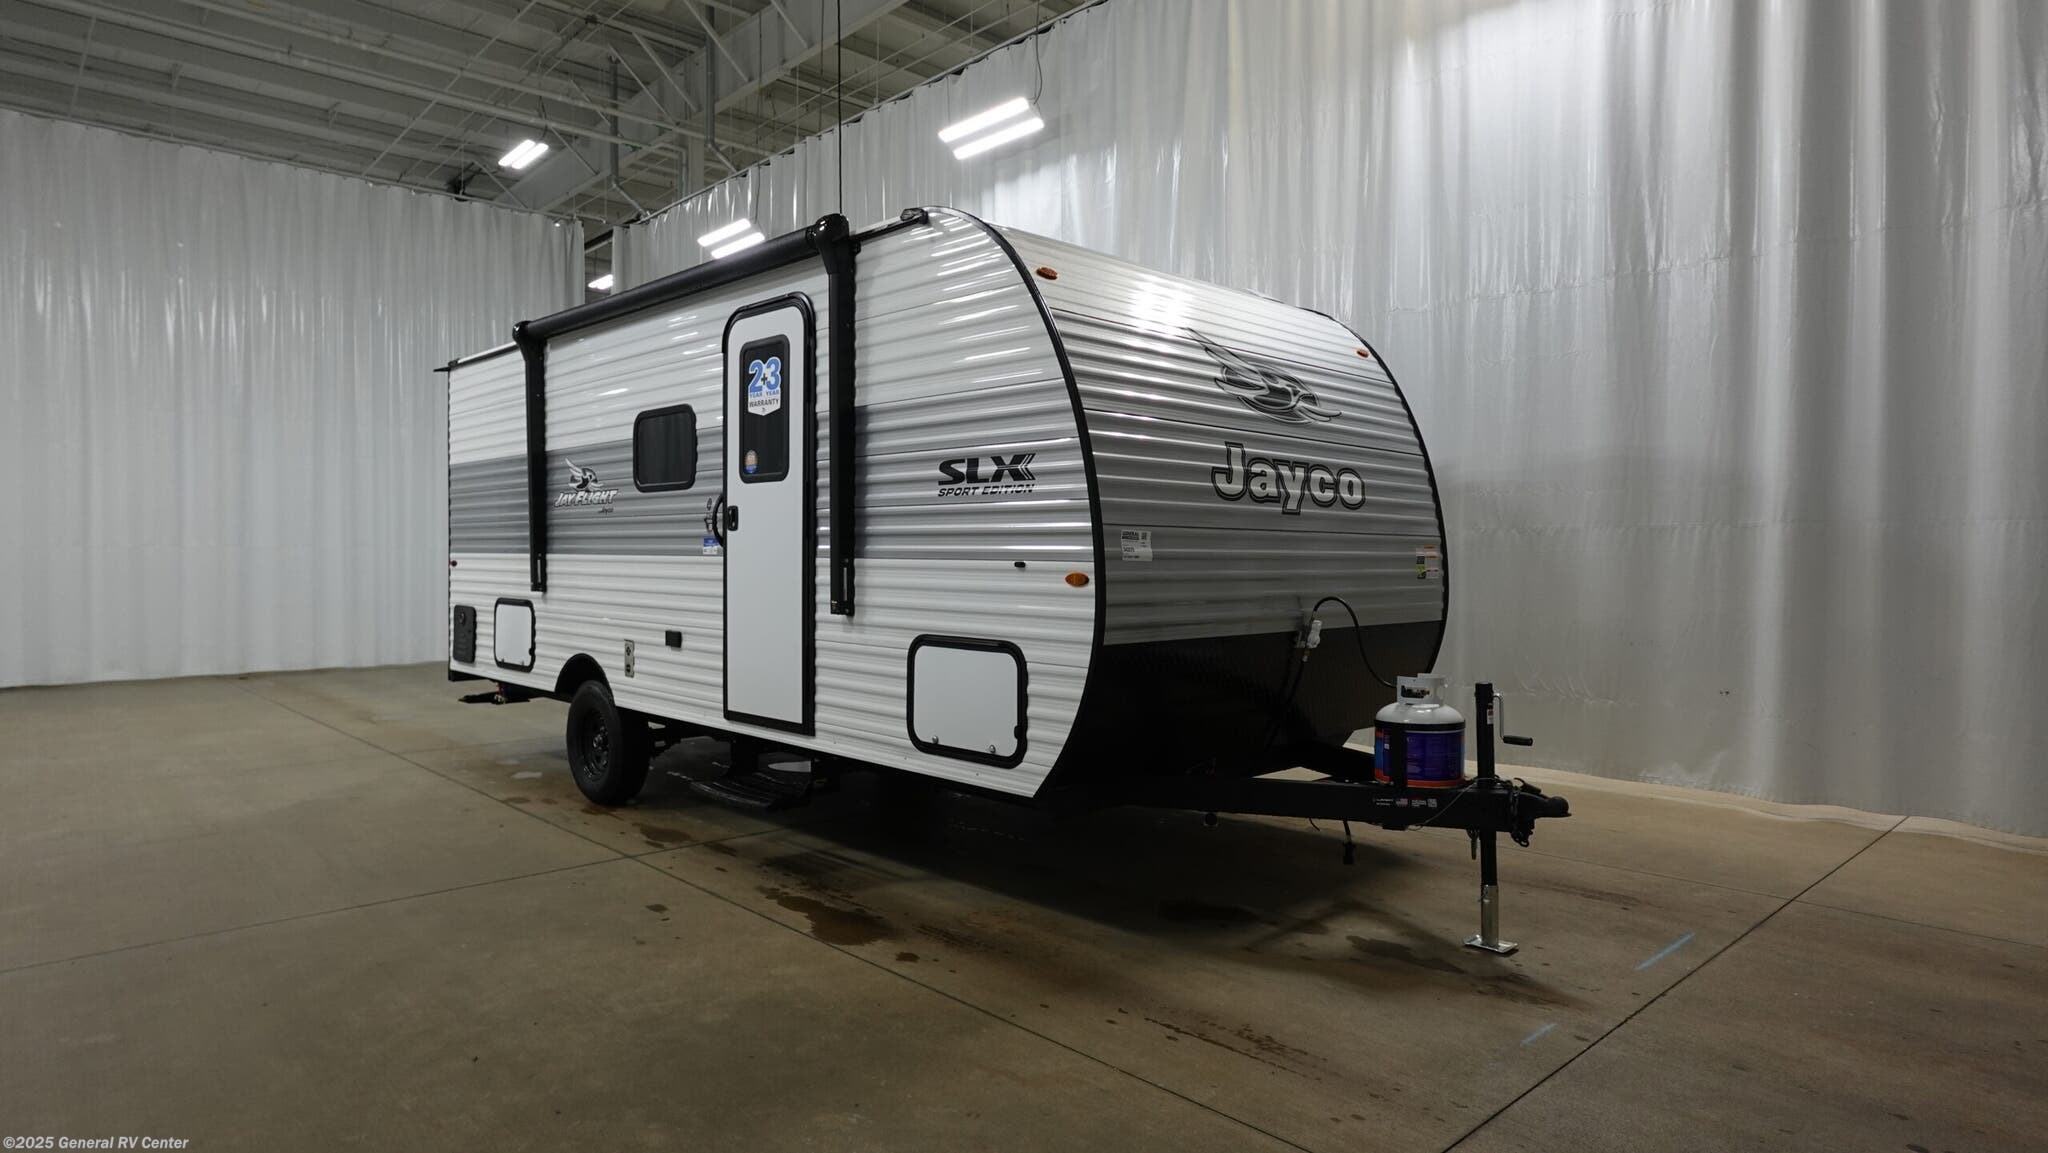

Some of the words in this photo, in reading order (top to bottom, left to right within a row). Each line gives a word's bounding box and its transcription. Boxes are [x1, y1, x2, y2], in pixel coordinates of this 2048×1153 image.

[749, 399, 779, 407] WARRANTY
[938, 453, 1036, 486] SLX
[1212, 441, 1366, 515] Jayco
[554, 492, 577, 507] JAY
[574, 489, 618, 505] FLIGHT
[938, 486, 979, 497] SPORT
[982, 484, 1035, 495] EDITION
